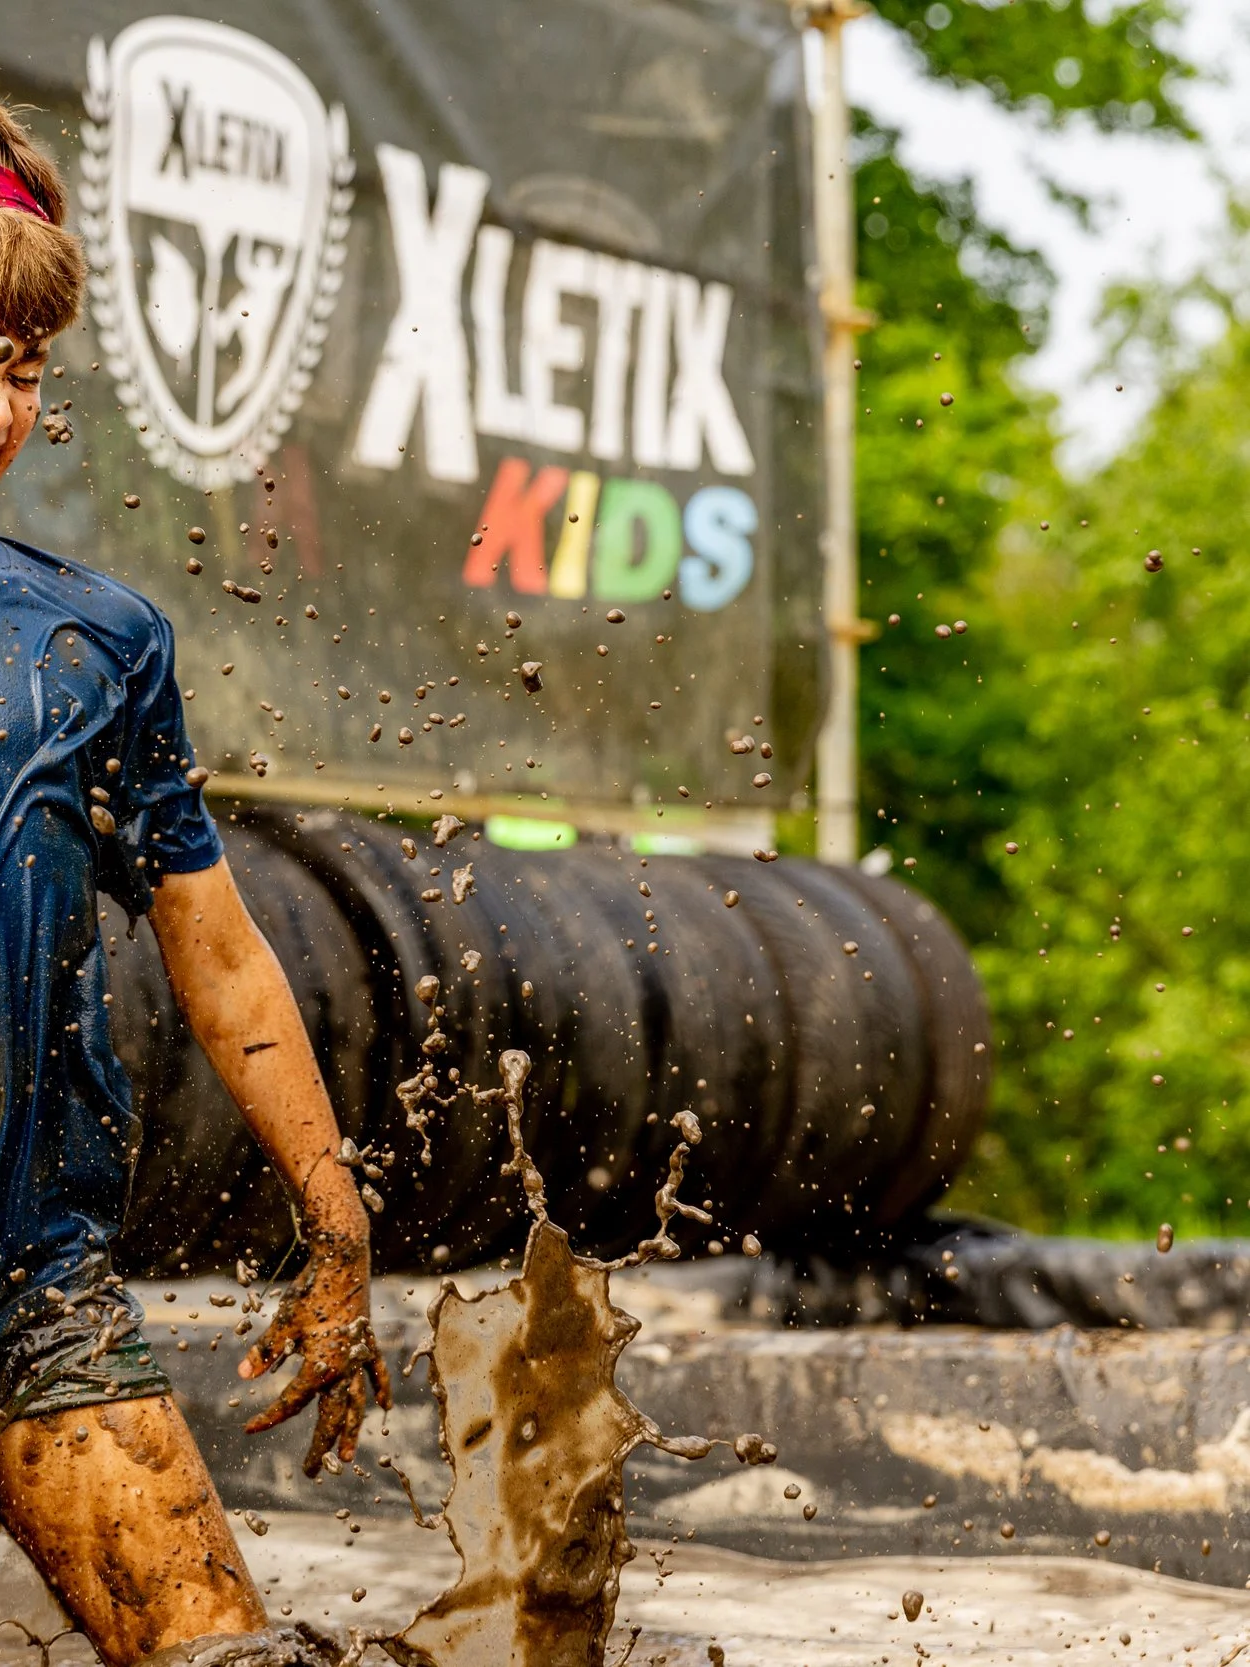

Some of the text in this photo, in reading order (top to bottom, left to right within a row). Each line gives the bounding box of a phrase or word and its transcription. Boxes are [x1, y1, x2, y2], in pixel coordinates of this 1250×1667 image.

[160, 78, 289, 185] XLETIX
[355, 143, 754, 483] XLETIX
[463, 457, 757, 612] KIDS
